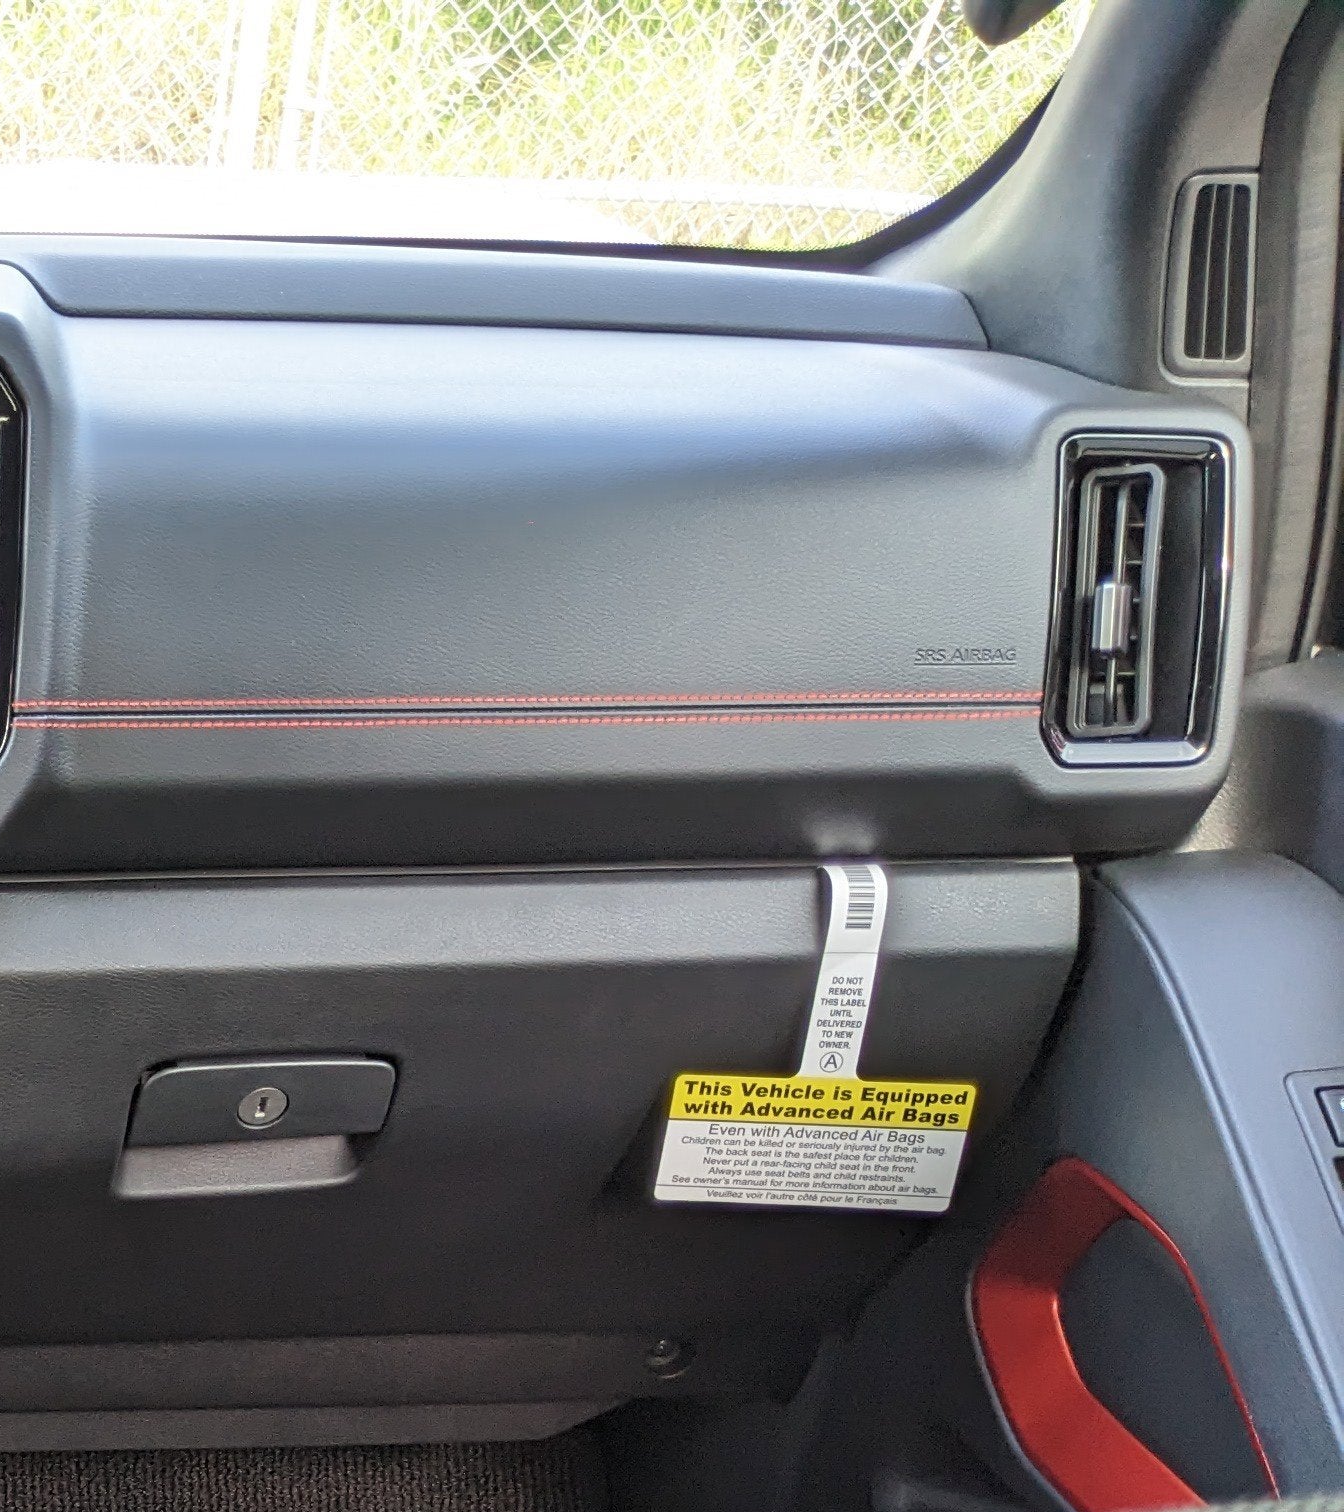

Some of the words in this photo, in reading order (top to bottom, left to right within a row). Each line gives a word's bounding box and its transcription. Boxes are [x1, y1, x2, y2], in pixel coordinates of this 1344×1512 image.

[914, 647, 948, 662] SRS
[950, 647, 1017, 662] AIRBAG
[832, 976, 845, 984] DO
[846, 977, 864, 985] NOT
[828, 987, 863, 996] REMOVE
[820, 997, 839, 1006] THIS
[840, 998, 867, 1007] LABEL
[830, 1009, 853, 1018] UNTIL
[816, 1019, 863, 1029] DELIVERED
[822, 1030, 833, 1038] TO
[834, 1031, 854, 1039] NEW
[818, 1040, 851, 1049] OWNER.
[823, 1054, 838, 1069] A
[684, 1080, 732, 1096] This
[741, 1082, 826, 1101] Vehicle
[832, 1086, 853, 1101] is
[860, 1087, 969, 1108] Equipped
[683, 1100, 733, 1116] with
[739, 1101, 855, 1120] Advanced
[860, 1106, 896, 1122] Air
[902, 1107, 960, 1127] Bags
[708, 1123, 746, 1137] Even
[750, 1125, 780, 1138] with
[783, 1126, 859, 1141] Advanced
[861, 1129, 883, 1142] Air
[887, 1130, 926, 1146] Bags
[681, 1135, 721, 1146] Children
[723, 1138, 741, 1146] can
[743, 1137, 756, 1147] be
[759, 1138, 783, 1148] killed
[786, 1140, 795, 1149] or
[798, 1140, 841, 1151] seriously
[844, 1142, 877, 1153] injured
[879, 1143, 891, 1154] by
[893, 1143, 909, 1153] the
[912, 1145, 923, 1154] air
[705, 1146, 722, 1155] The
[725, 1146, 748, 1156] back
[751, 1148, 772, 1157] seat
[774, 1148, 782, 1158] is
[784, 1149, 800, 1158] the
[802, 1150, 832, 1160] safest
[833, 1151, 860, 1162] place
[862, 1152, 876, 1161] for
[878, 1153, 919, 1164] children.
[672, 1175, 690, 1184] See
[693, 1176, 730, 1185] owner's
[732, 1177, 768, 1186] manual
[769, 1178, 783, 1187] for
[785, 1180, 810, 1188] more
[812, 1180, 866, 1191] information
[867, 1182, 896, 1192] about
[897, 1184, 911, 1193] air
